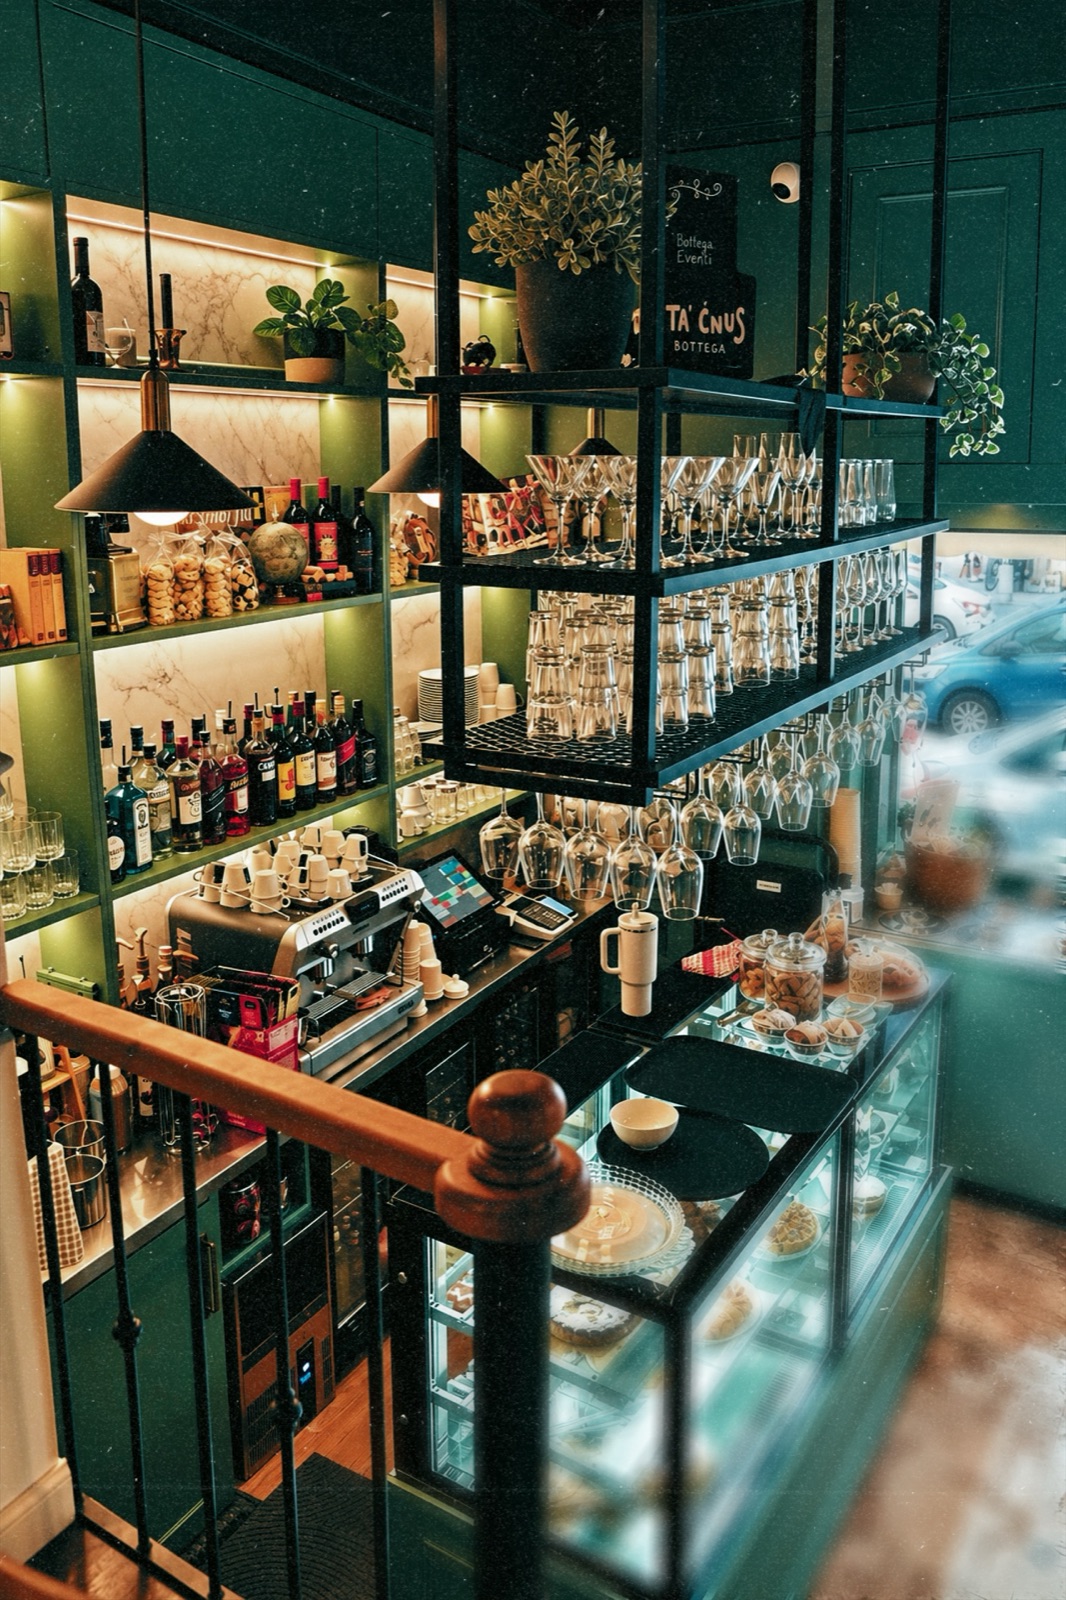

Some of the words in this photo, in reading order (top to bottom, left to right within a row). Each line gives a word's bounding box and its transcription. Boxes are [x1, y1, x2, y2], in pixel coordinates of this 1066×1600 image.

[676, 232, 714, 256] Bottega
[676, 249, 713, 265] Eventi
[674, 340, 726, 354] BOTTEGA
